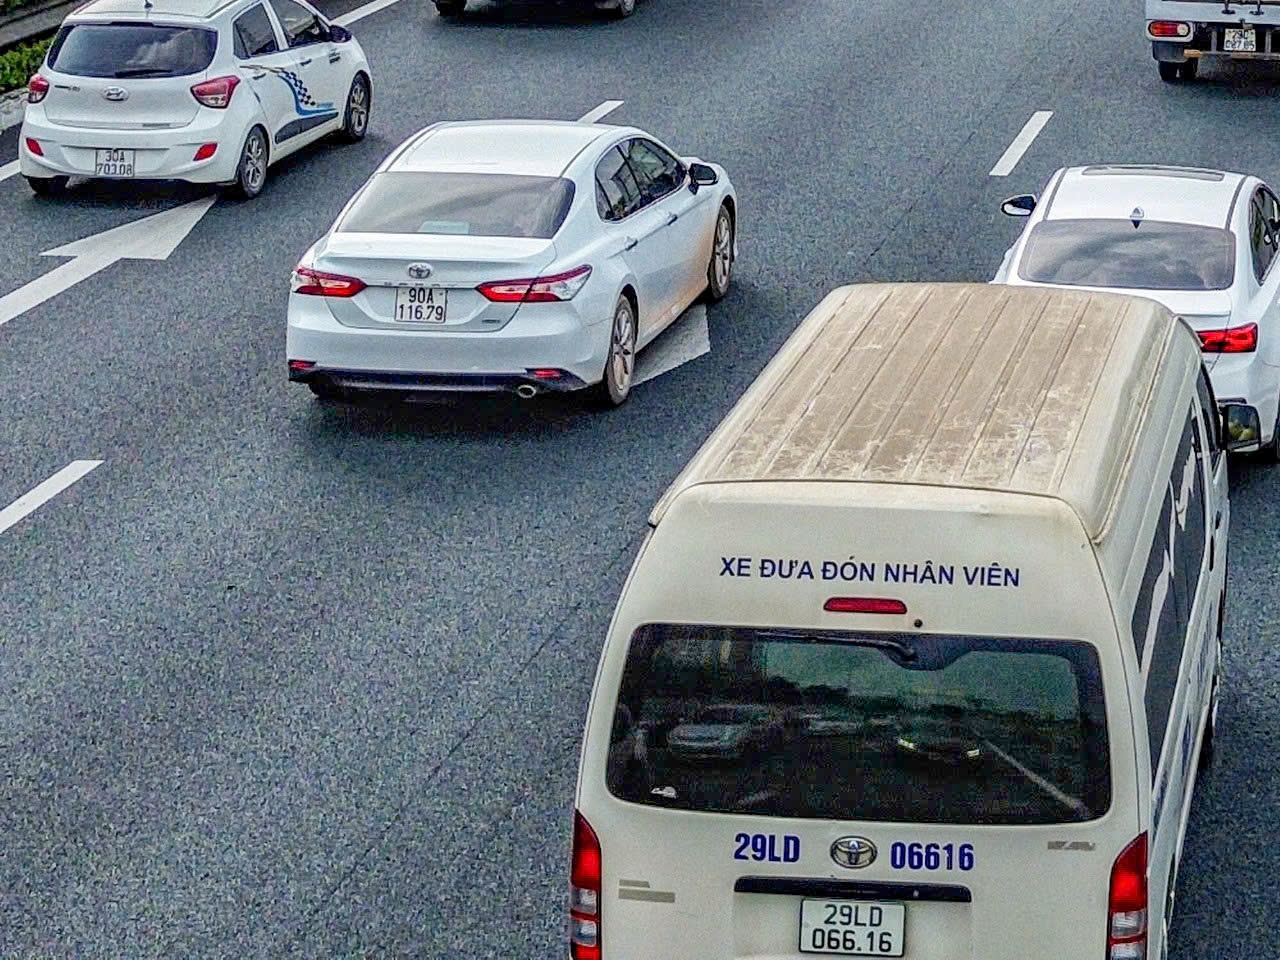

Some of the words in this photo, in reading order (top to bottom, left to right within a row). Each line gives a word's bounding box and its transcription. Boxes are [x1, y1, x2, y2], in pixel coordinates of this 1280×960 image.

[105, 150, 125, 163] 30A
[408, 287, 434, 304] 90A
[399, 304, 444, 321] 116.79
[719, 557, 751, 577] XE
[758, 558, 815, 580] ĐƯA
[821, 556, 876, 582] ĐÓN
[883, 560, 955, 585] NHÂN
[963, 561, 1020, 587] VIÊN
[733, 832, 801, 863] 29LD
[890, 841, 975, 871] 06616
[823, 904, 883, 927] 29LD
[811, 928, 893, 953] 066.16
